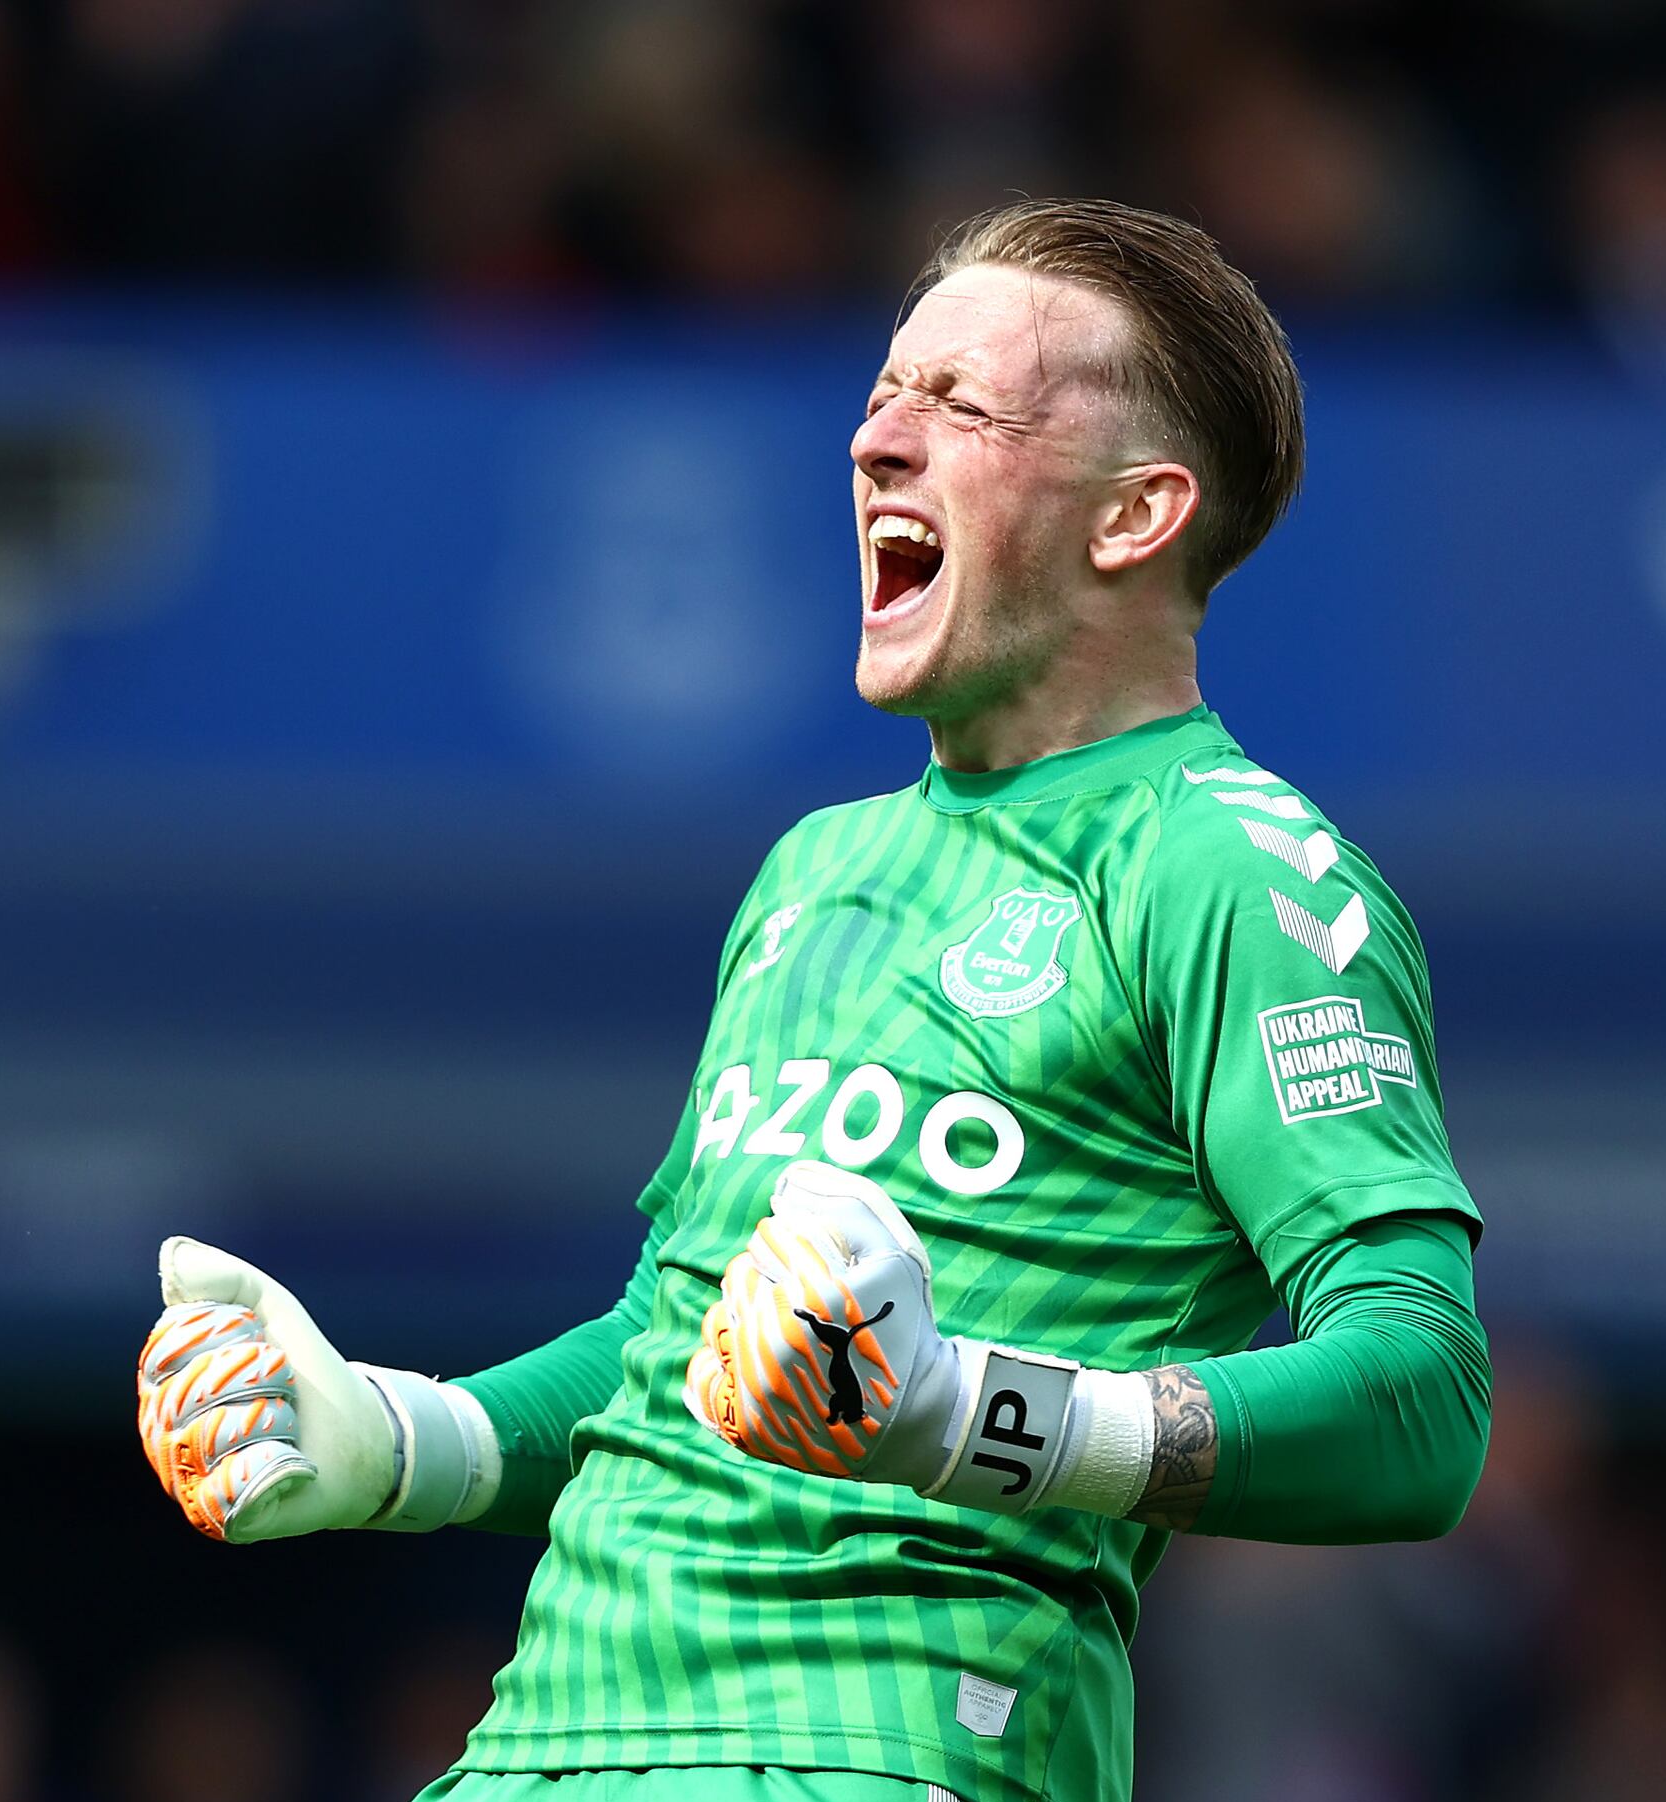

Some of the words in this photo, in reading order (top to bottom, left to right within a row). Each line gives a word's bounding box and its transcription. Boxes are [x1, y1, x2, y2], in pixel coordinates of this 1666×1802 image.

[970, 951, 1031, 978] Everton
[1268, 1005, 1360, 1047] UKRAINE
[1286, 1069, 1370, 1113] APPEAL
[691, 1057, 1026, 1196] AZOO
[970, 1388, 1046, 1496] JP
[963, 1689, 1007, 1709] AUTHENTIC
